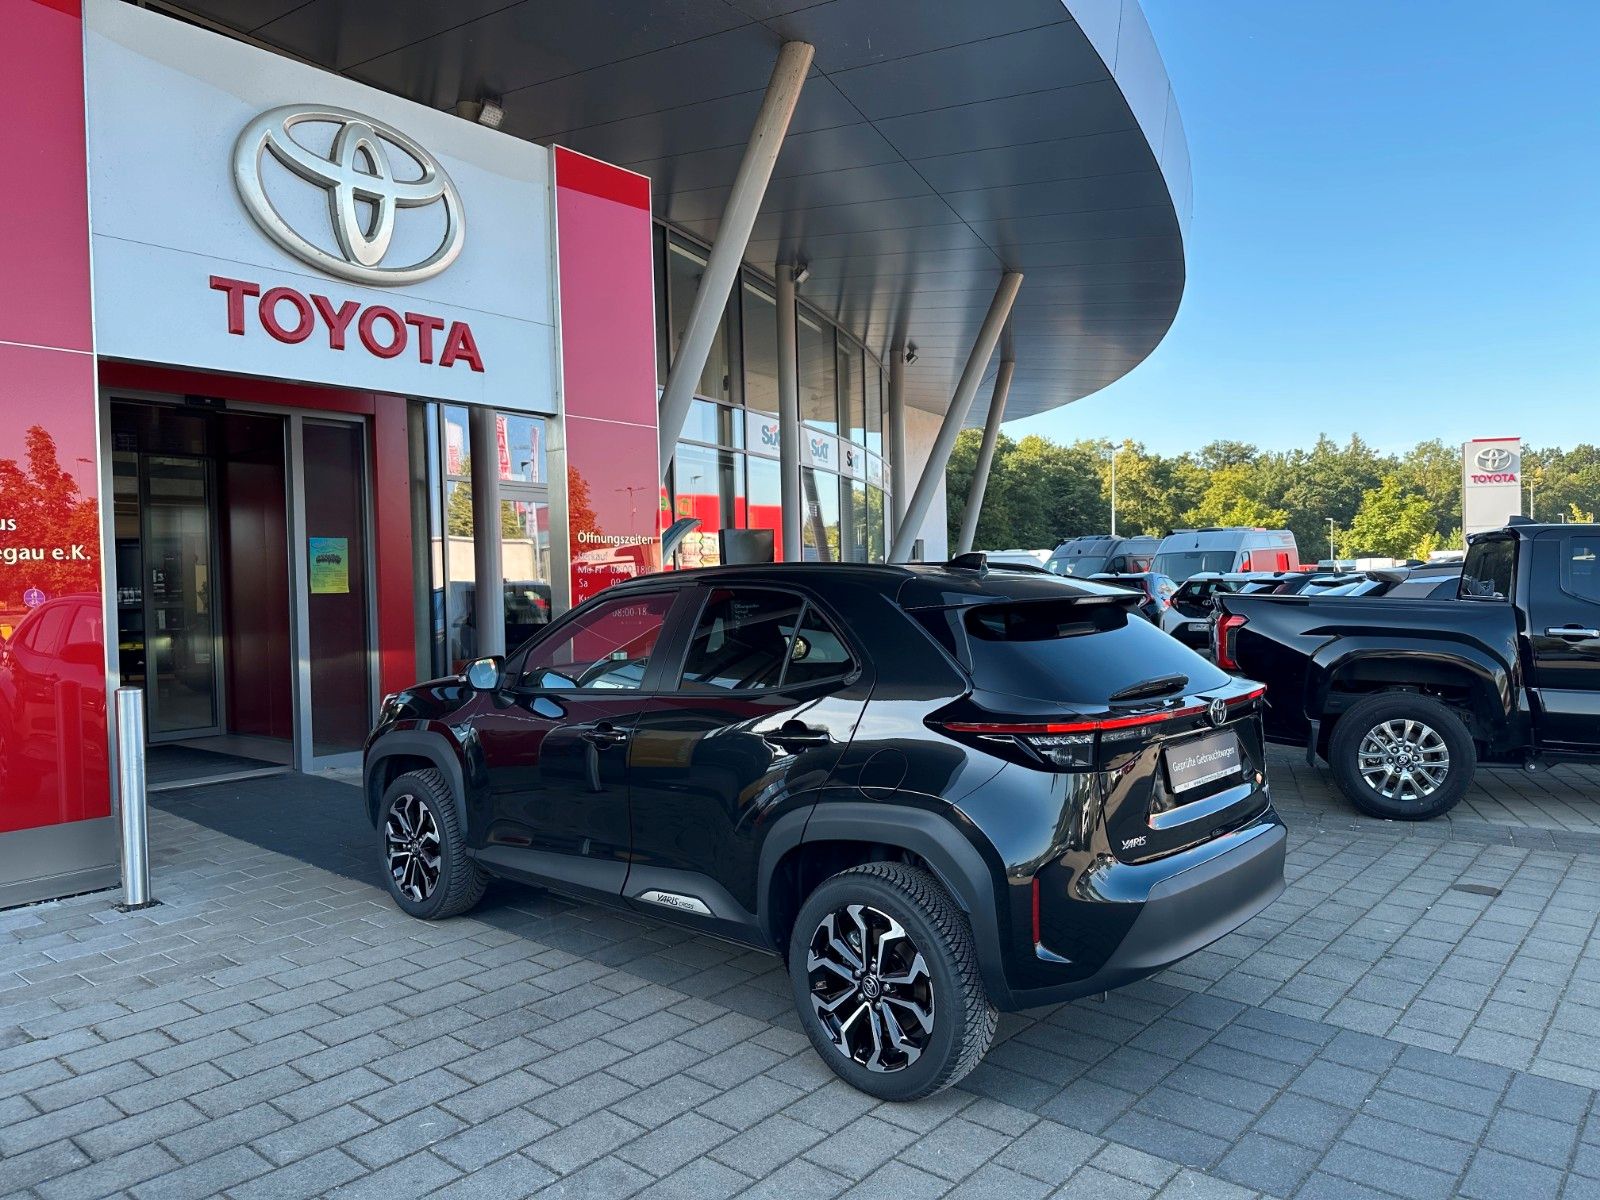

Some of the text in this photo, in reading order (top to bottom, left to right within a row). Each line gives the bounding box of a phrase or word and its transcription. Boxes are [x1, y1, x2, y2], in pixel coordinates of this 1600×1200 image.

[209, 274, 485, 373] TOYOTA
[1471, 473, 1517, 484] TOYOTA
[577, 530, 654, 547] Öffnungszeiten
[0, 544, 91, 565] gau e.K.
[578, 578, 589, 588] Sa
[656, 893, 679, 906] YARIS
